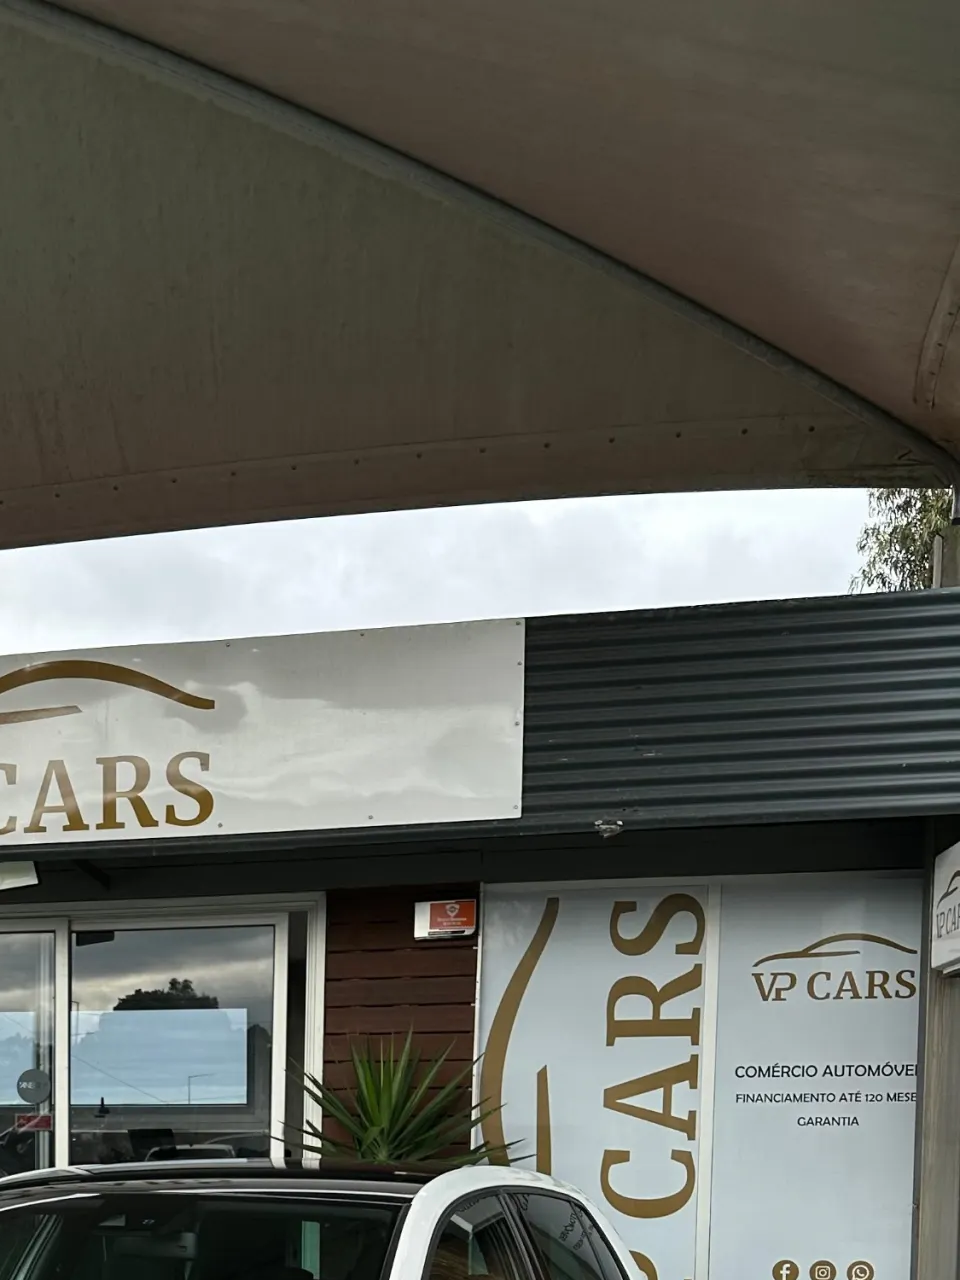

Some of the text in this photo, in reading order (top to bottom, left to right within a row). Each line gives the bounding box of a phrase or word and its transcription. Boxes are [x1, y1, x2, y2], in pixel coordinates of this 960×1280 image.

[751, 969, 917, 1002] VP CARS
[600, 893, 706, 1219] CARS
[735, 1063, 818, 1078] COMÉRCIO
[735, 1093, 836, 1104] FINANCIAMENTO
[839, 1091, 862, 1103] ATÉ
[865, 1093, 883, 1103] 120
[797, 1116, 860, 1127] GARANTIA
